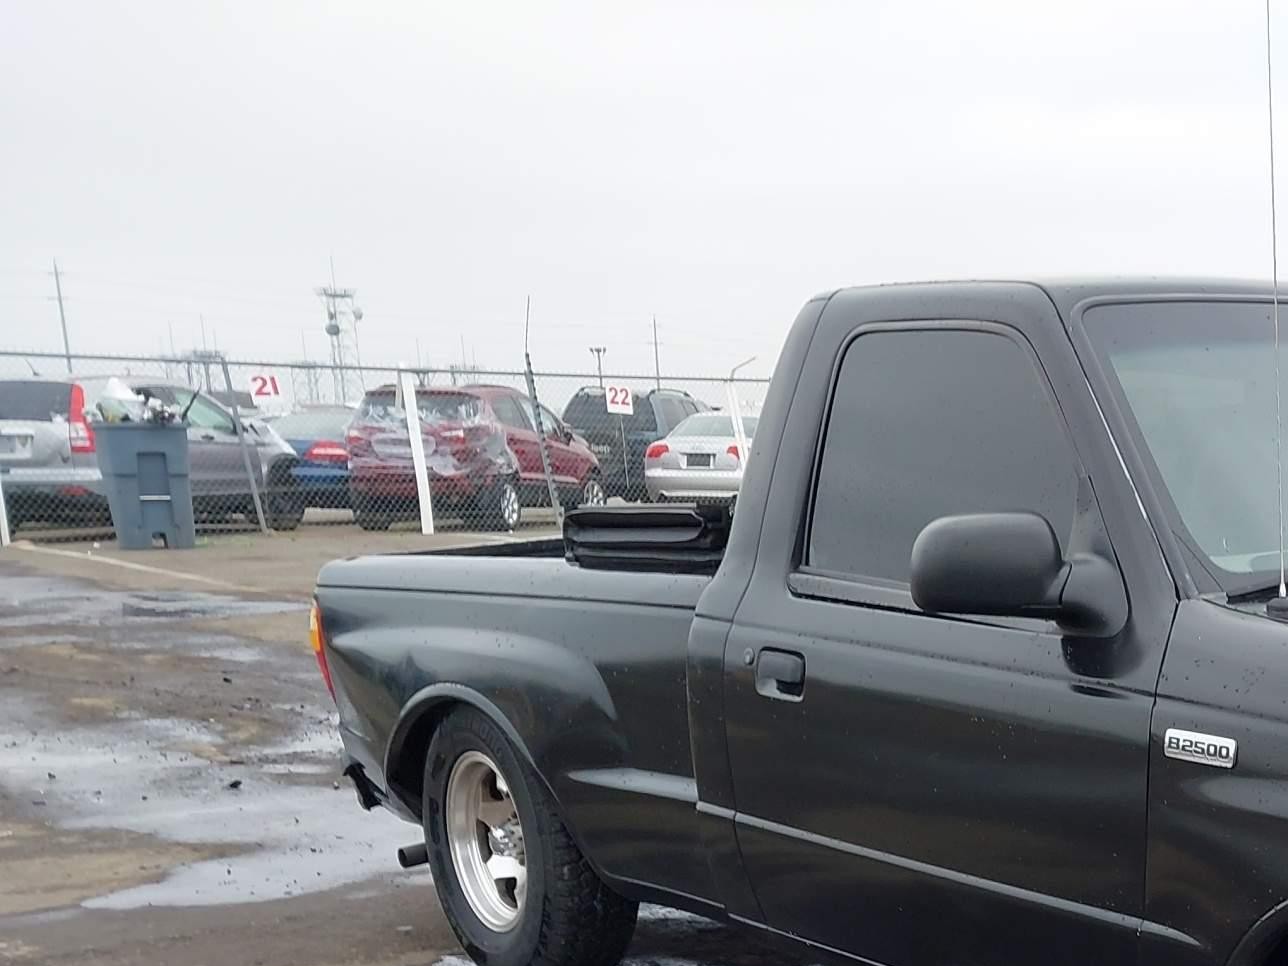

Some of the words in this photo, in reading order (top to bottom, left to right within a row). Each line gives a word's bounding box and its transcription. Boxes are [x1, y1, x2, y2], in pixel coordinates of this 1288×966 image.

[251, 376, 280, 396] 21
[609, 387, 630, 405] 22
[1167, 736, 1230, 760] B2500
